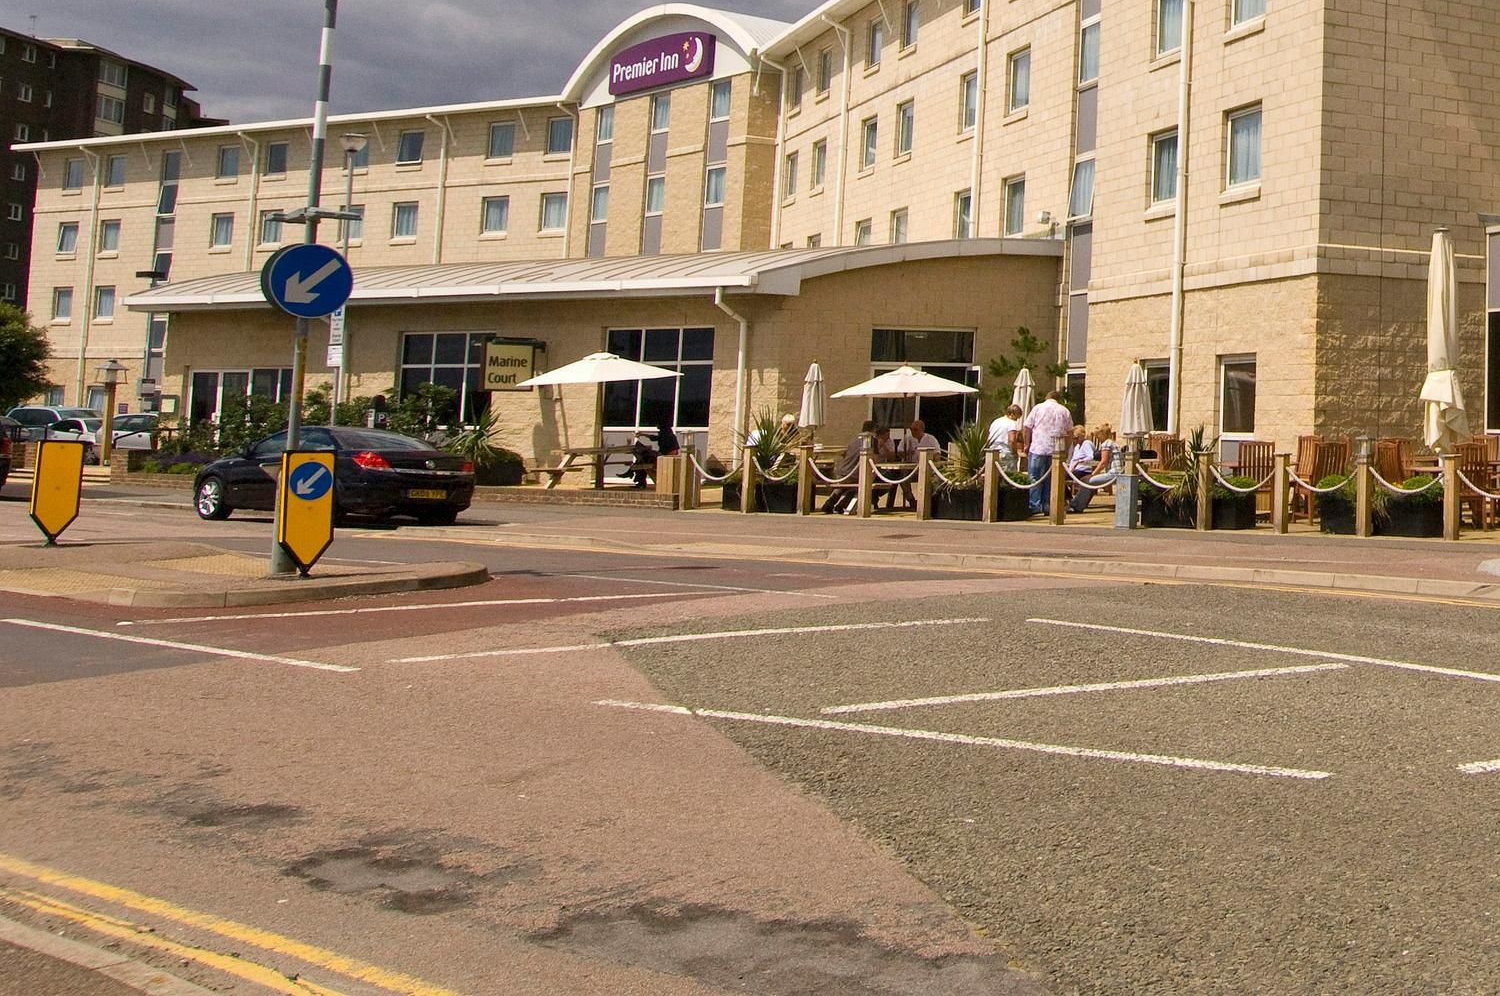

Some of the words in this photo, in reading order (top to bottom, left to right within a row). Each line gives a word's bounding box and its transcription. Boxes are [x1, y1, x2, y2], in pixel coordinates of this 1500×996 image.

[613, 57, 658, 83] Premier
[660, 52, 679, 72] Inn
[488, 355, 528, 368] Marine
[487, 372, 517, 384] Court
